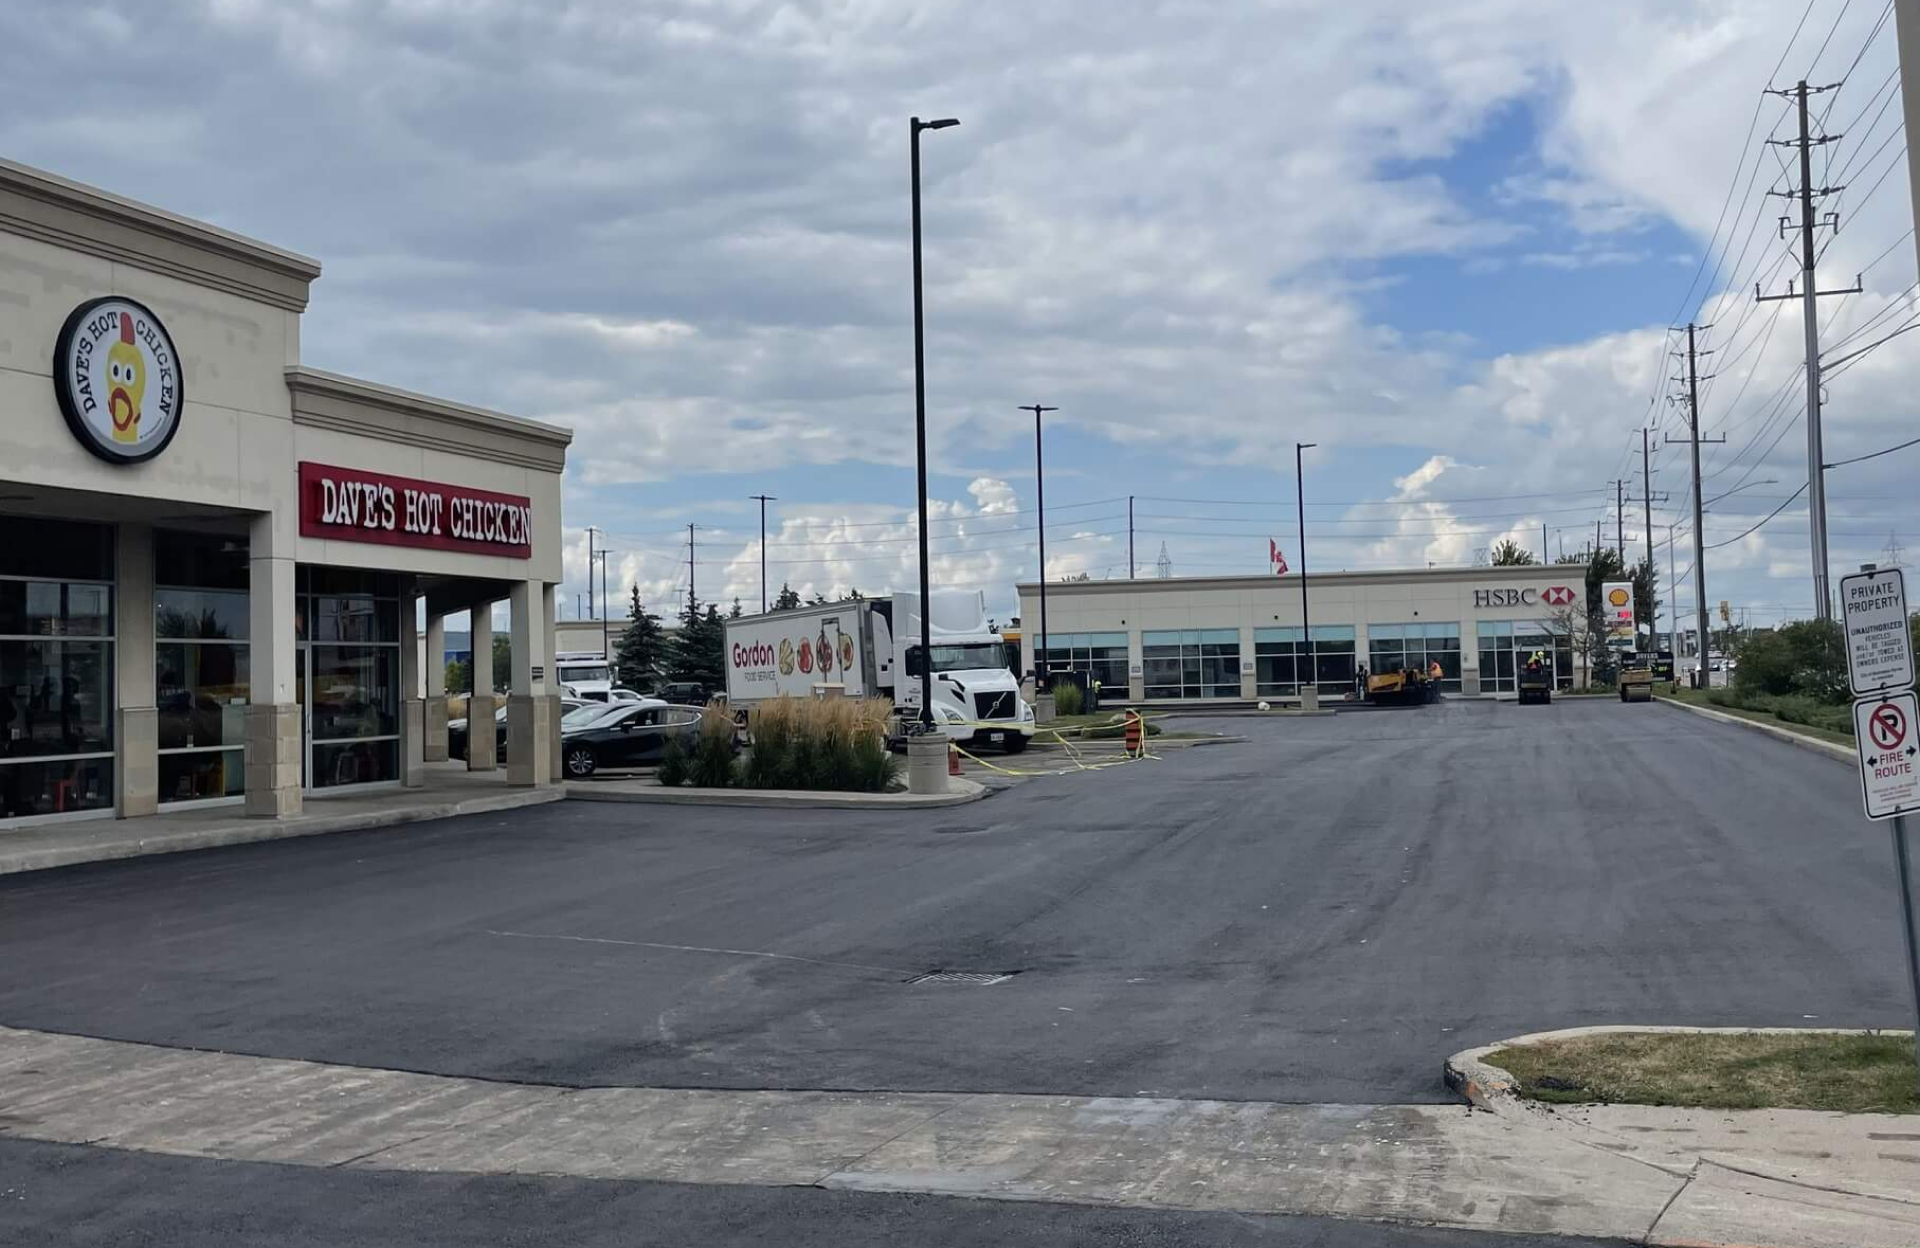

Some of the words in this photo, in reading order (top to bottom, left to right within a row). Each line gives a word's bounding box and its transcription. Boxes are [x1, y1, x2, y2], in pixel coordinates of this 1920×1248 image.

[76, 337, 97, 414] DAVE'S
[88, 311, 119, 341] HOT
[135, 319, 174, 416] CHICKEN
[321, 478, 396, 530] DAVE'S
[404, 489, 442, 535] HOT
[450, 496, 531, 546] CHICKEN
[1473, 587, 1537, 608] HSBC
[1851, 582, 1894, 599] PRIVATE
[1848, 595, 1900, 614] PROPERTY
[1851, 620, 1903, 636] UNAUTHORIZED
[733, 639, 775, 668] Gordon
[1879, 751, 1904, 766] FIRE
[1875, 763, 1912, 779] ROUTE
